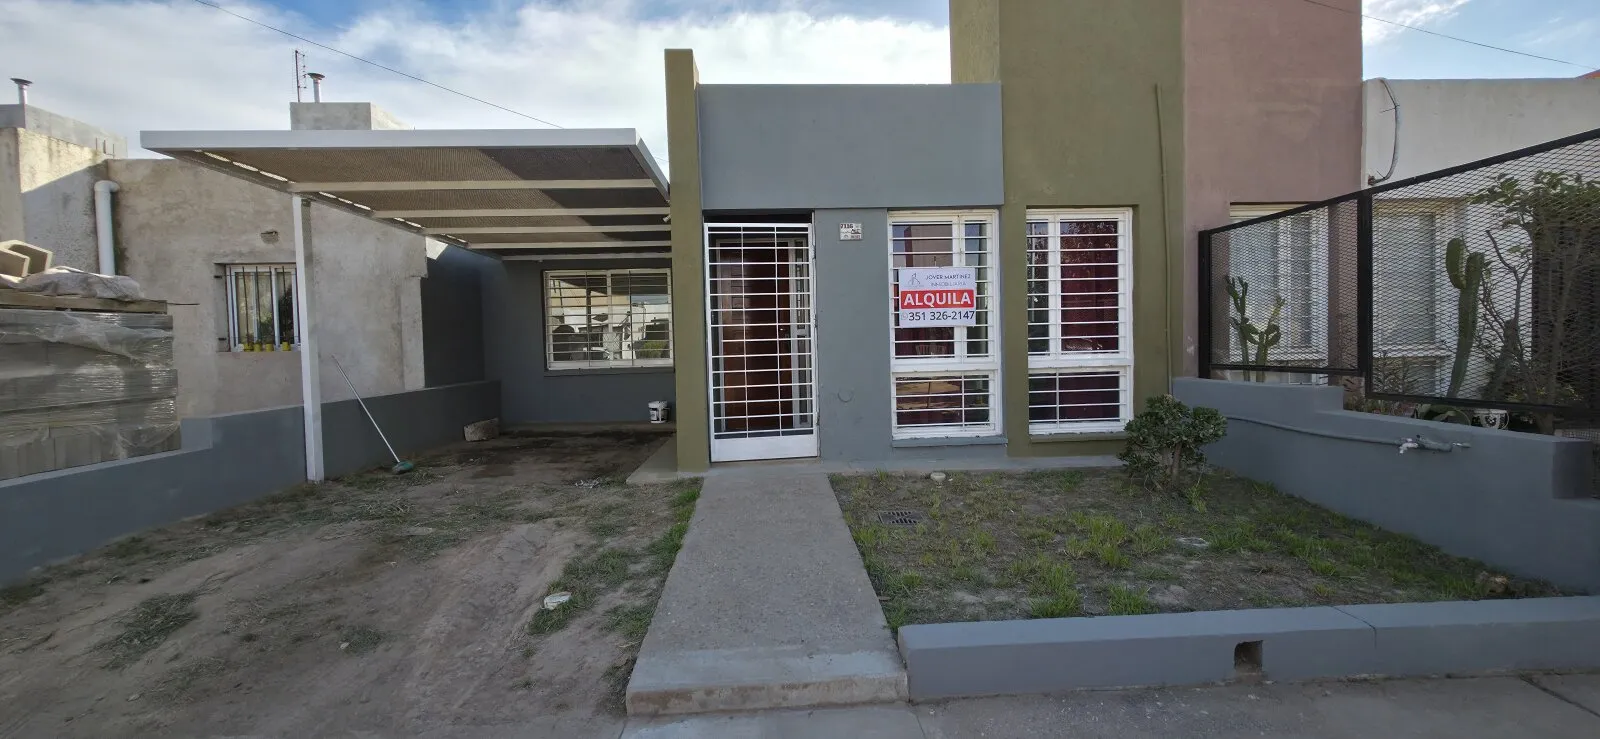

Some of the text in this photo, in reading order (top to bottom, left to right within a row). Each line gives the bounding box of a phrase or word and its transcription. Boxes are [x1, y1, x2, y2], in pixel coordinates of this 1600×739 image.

[903, 292, 972, 308] ALQUILA
[908, 310, 975, 321] 351 326-2147
